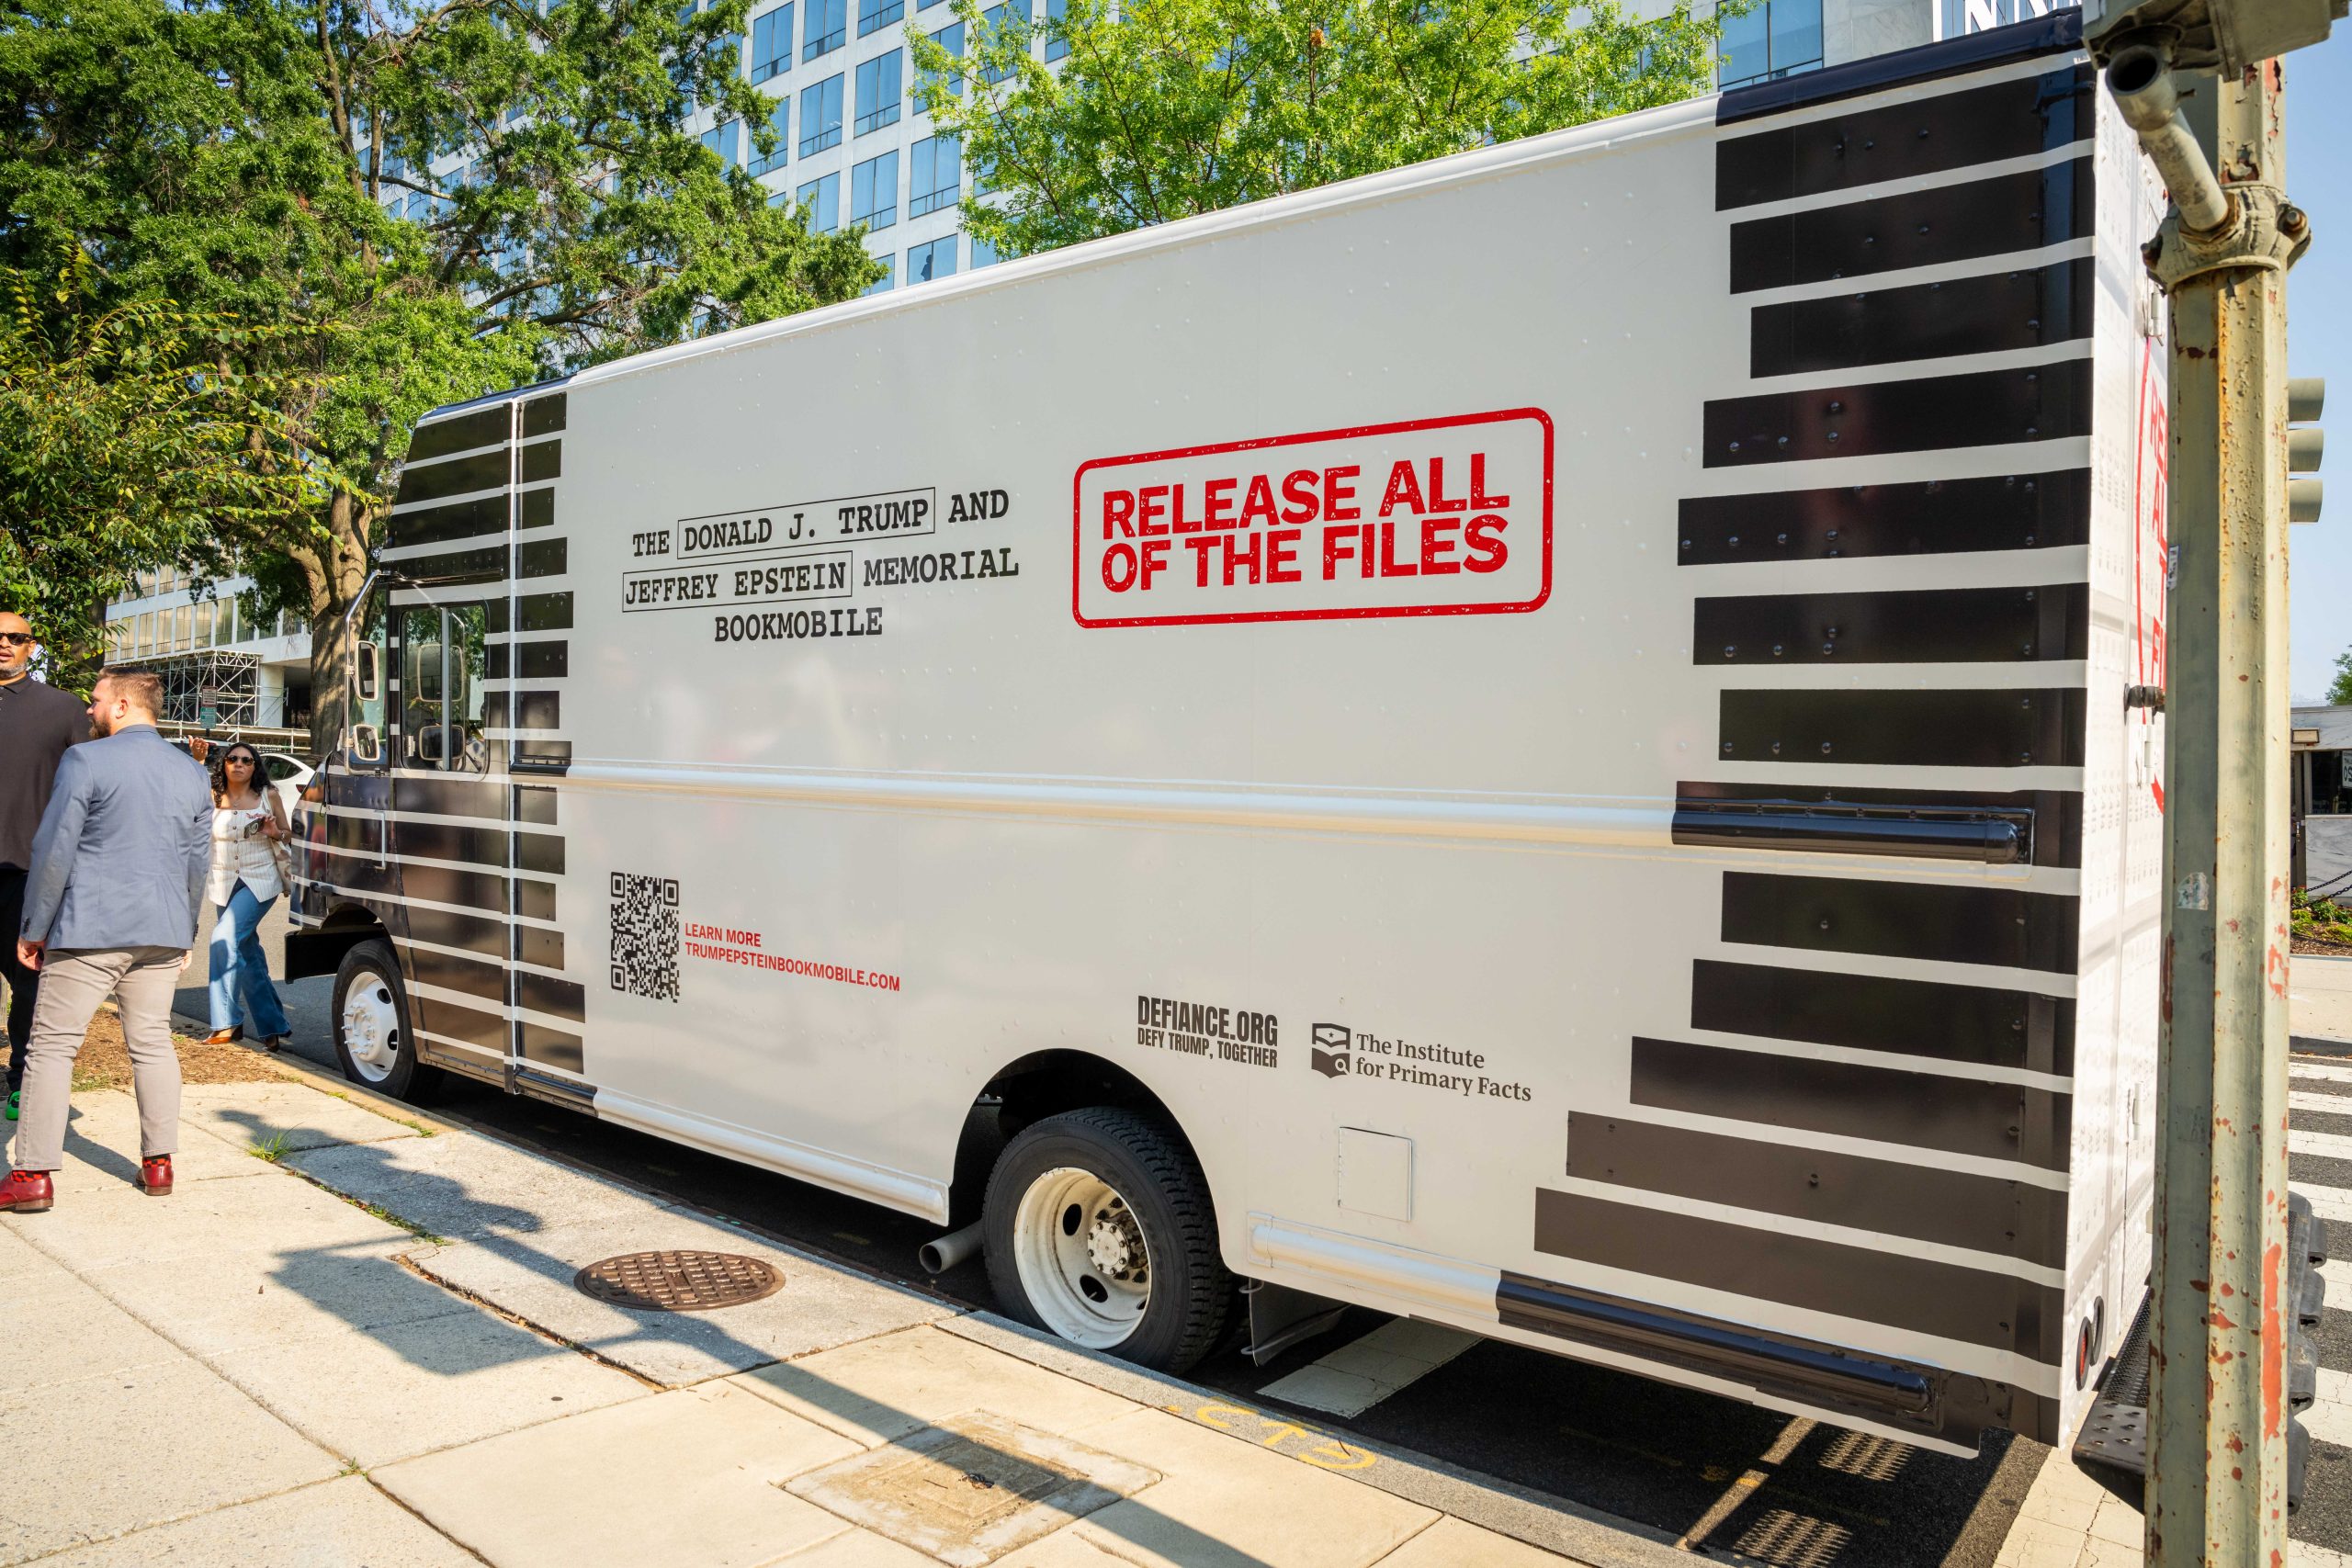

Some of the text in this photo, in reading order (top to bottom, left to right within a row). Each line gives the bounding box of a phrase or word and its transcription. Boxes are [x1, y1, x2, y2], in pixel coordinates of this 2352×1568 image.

[1102, 453, 1510, 540] RELEASE ALL
[633, 488, 1010, 557] THE DONALD J. TRUMP AND
[626, 547, 1019, 604] JEFFREY EPSTEIN MEMORIAL
[1102, 514, 1509, 593] OF THE FILES
[715, 607, 882, 641] BOOKMOBILE
[685, 922, 762, 947] LEARN MORE
[685, 942, 900, 990] TRUMPEPSTEINBOOKMOBILE.COM
[1138, 996, 1277, 1046] DEFIANCE.ORG
[1138, 1028, 1277, 1067] DEFY TRUMP, TOGETHER
[1357, 1034, 1484, 1068] The Institute
[1356, 1057, 1531, 1101] for Primary Facts
